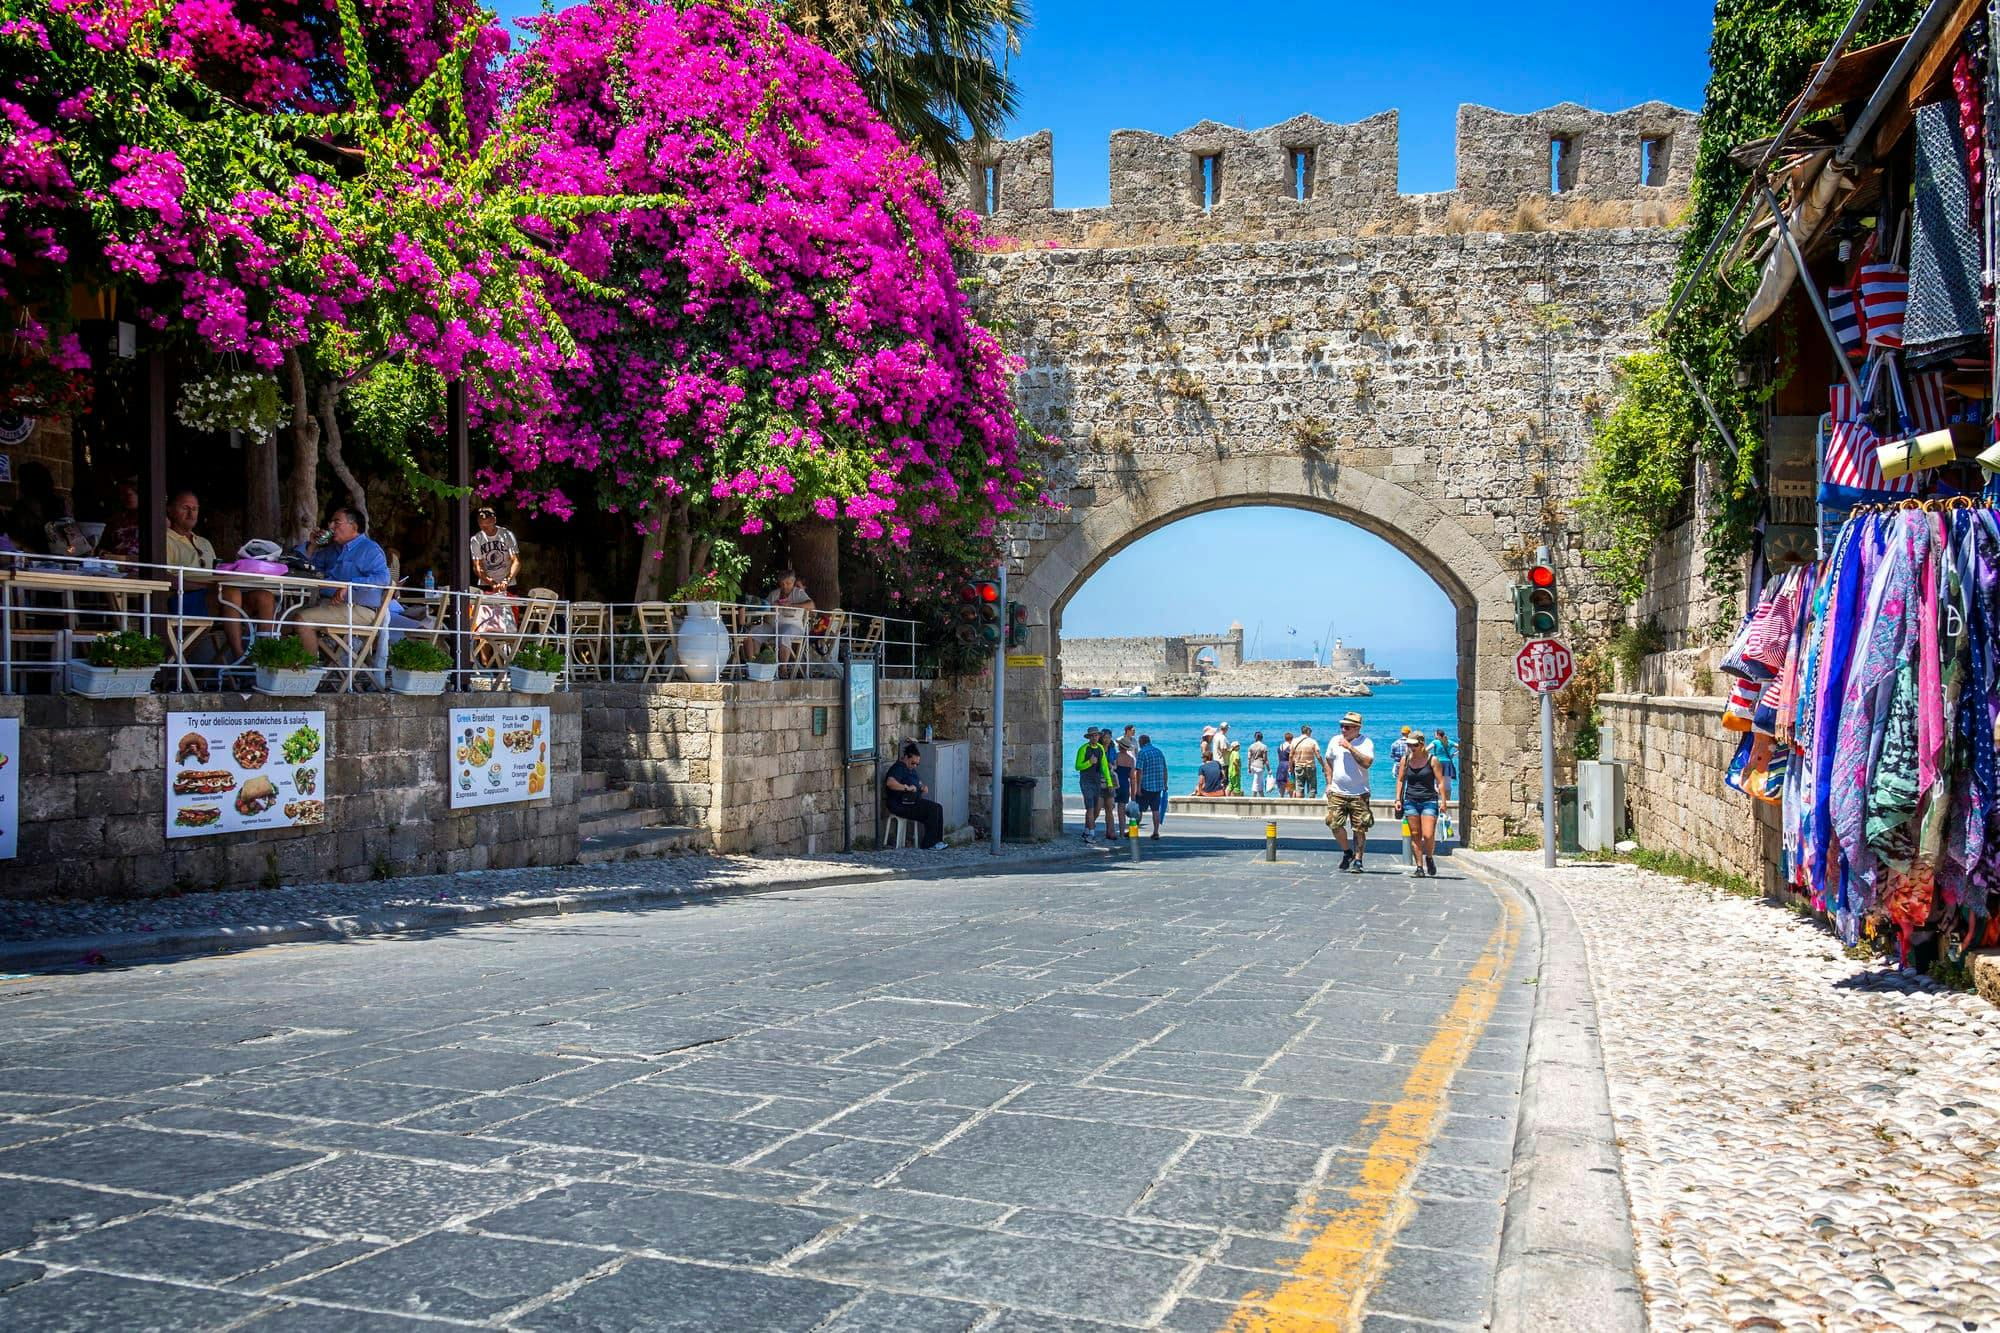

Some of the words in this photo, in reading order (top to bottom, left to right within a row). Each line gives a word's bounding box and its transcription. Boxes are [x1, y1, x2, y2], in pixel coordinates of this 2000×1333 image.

[481, 540, 508, 555] NIKE
[1519, 651, 1569, 682] STOP
[187, 717, 198, 728] Try
[201, 718, 212, 726] our
[212, 716, 242, 726] delicious
[243, 715, 282, 725] sandwiches
[283, 716, 288, 724] &
[289, 715, 308, 725] salads
[472, 713, 495, 722] Breakfast
[456, 791, 477, 799] Espresso
[484, 787, 509, 795] Cappuccino
